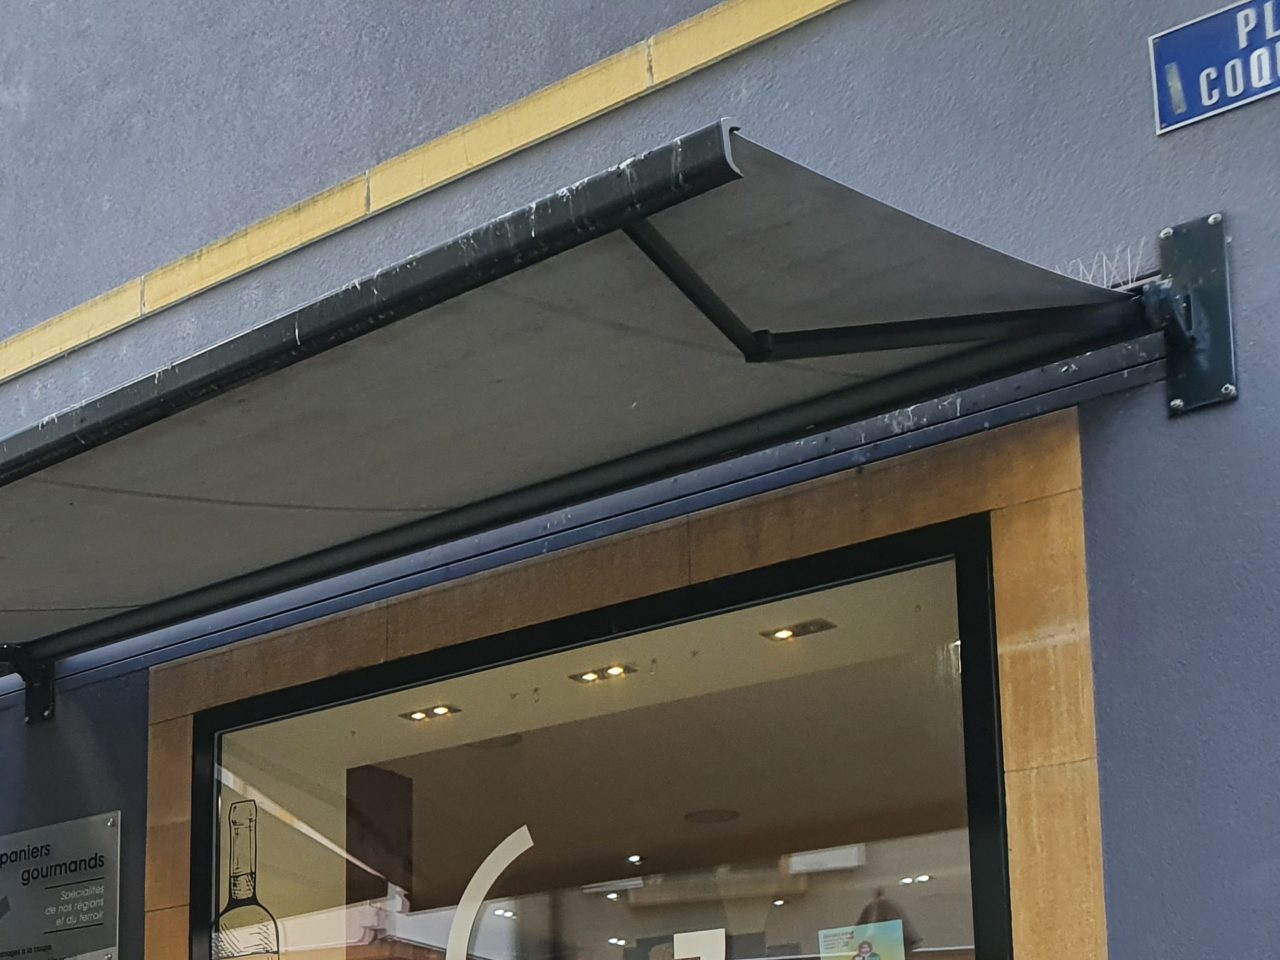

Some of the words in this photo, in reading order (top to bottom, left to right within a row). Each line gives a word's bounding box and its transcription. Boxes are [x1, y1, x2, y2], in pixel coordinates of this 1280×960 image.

[1199, 39, 1280, 107] COQ
[0, 843, 51, 869] paniers
[21, 852, 105, 886] gourmands
[60, 885, 105, 901] Spécialités
[44, 905, 56, 916] de
[58, 903, 73, 913] nos
[74, 897, 105, 913] régions
[55, 916, 64, 927] et
[66, 914, 78, 925] du
[79, 909, 105, 922] terroir
